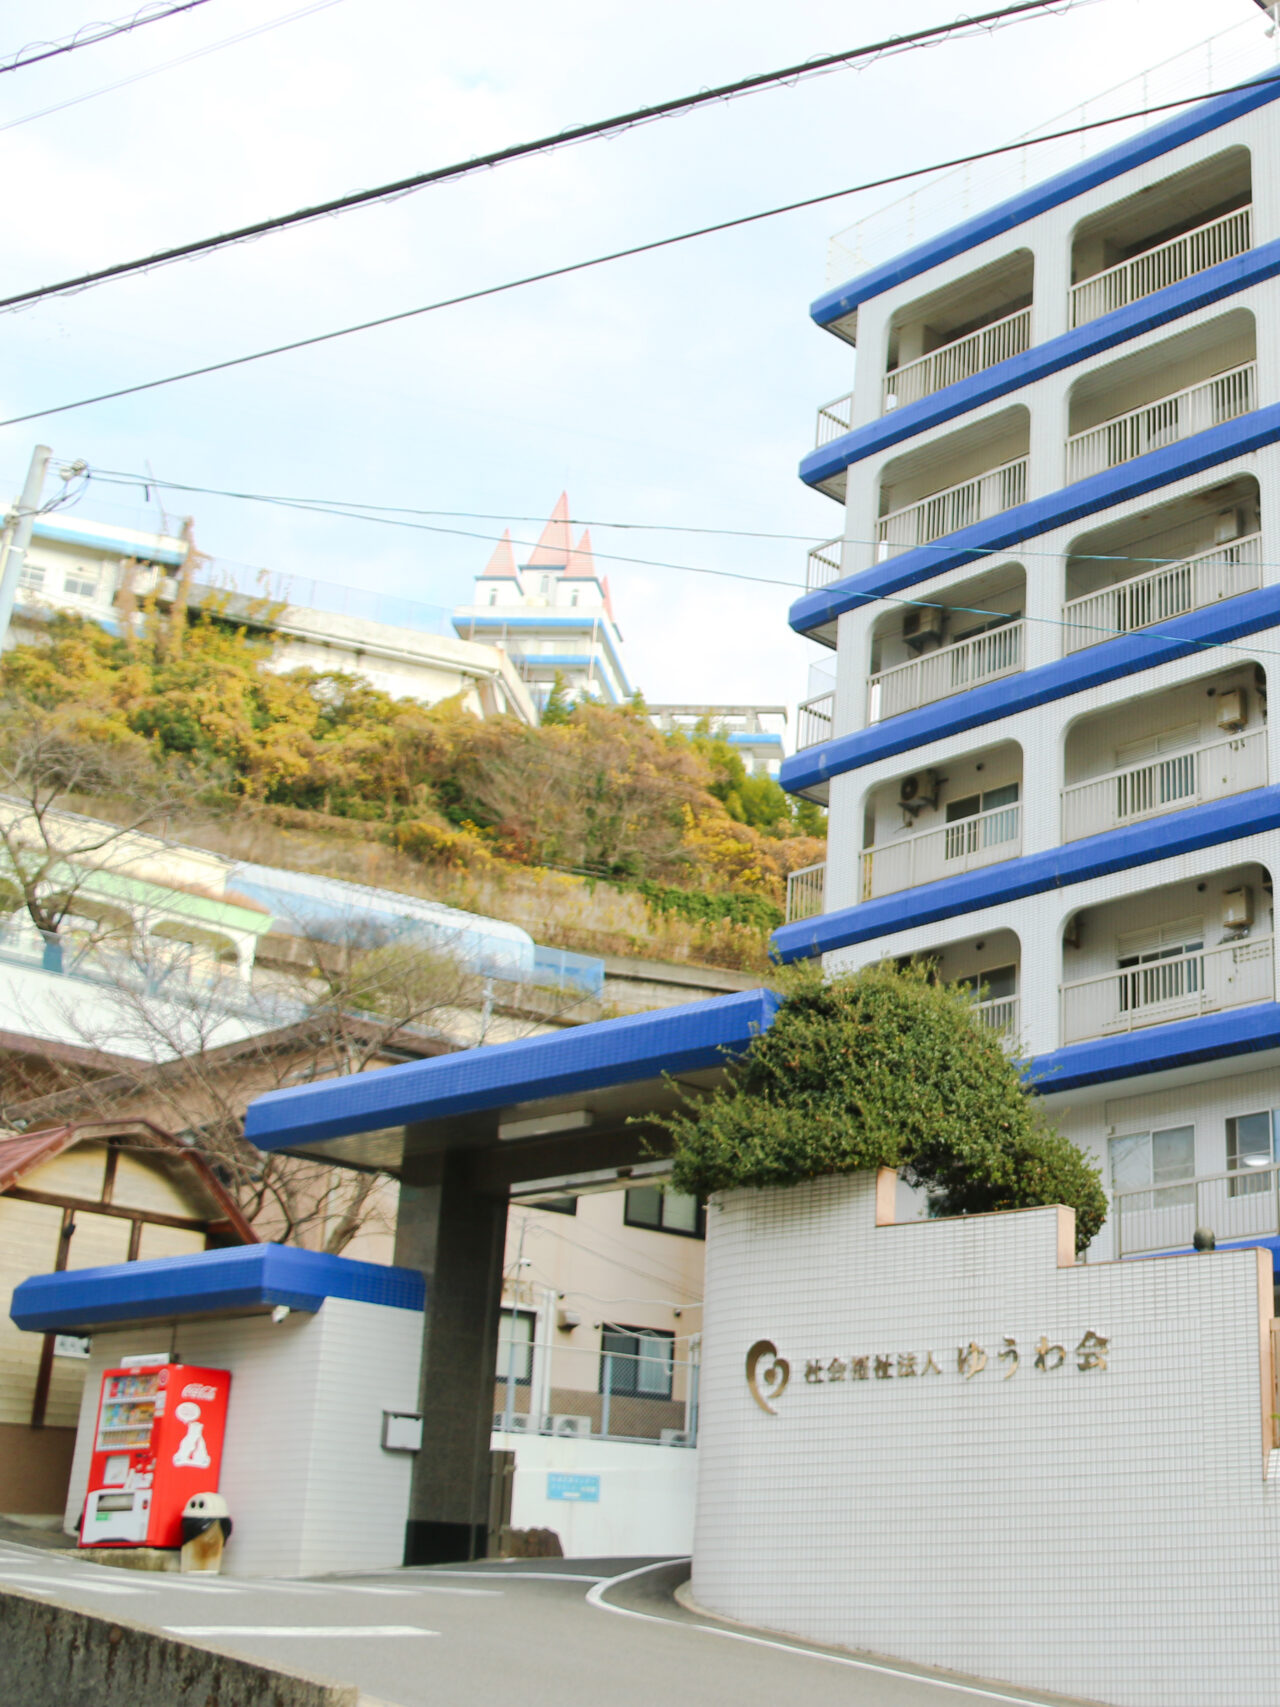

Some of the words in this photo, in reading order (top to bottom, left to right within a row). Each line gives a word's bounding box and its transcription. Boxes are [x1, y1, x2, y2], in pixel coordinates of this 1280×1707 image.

[804, 1350, 942, 1384] 社会福祉法人
[957, 1330, 1110, 1380] ゆうわ会
